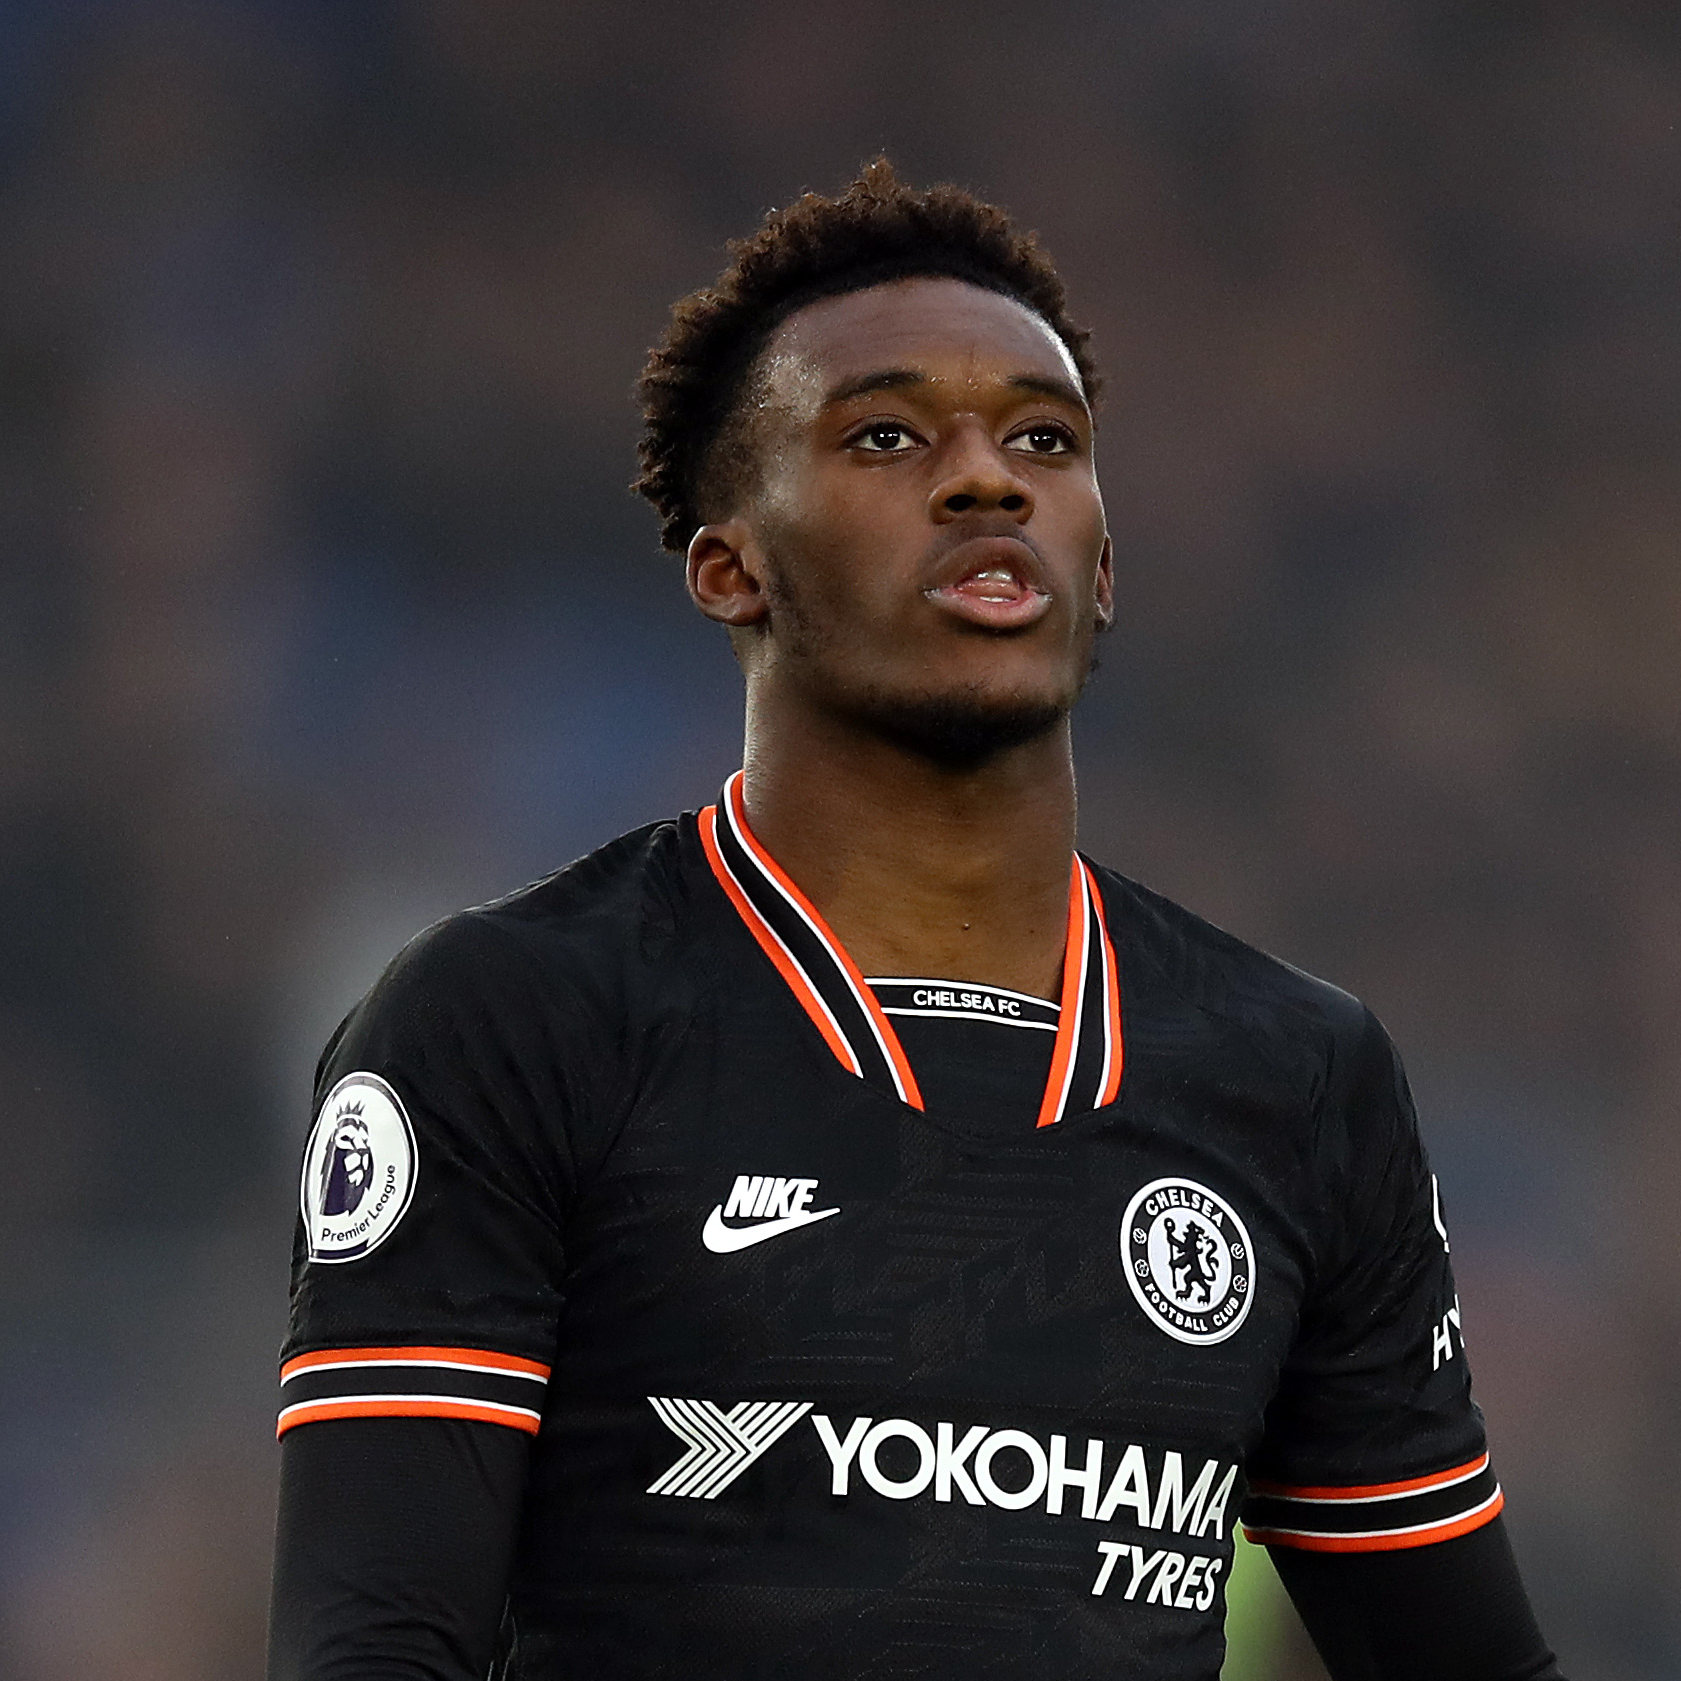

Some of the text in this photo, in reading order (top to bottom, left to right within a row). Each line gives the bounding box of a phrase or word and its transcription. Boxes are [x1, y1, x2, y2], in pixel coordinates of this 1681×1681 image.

[913, 990, 1021, 1016] CHELSEA FC
[321, 1164, 396, 1242] Premier League
[723, 1175, 819, 1217] NIKE
[1145, 1188, 1224, 1228] CHELSEA
[1144, 1282, 1239, 1332] FOOTBALL CLUB
[811, 1414, 1238, 1540] YOKOHAMA
[1091, 1541, 1222, 1611] TYRES
